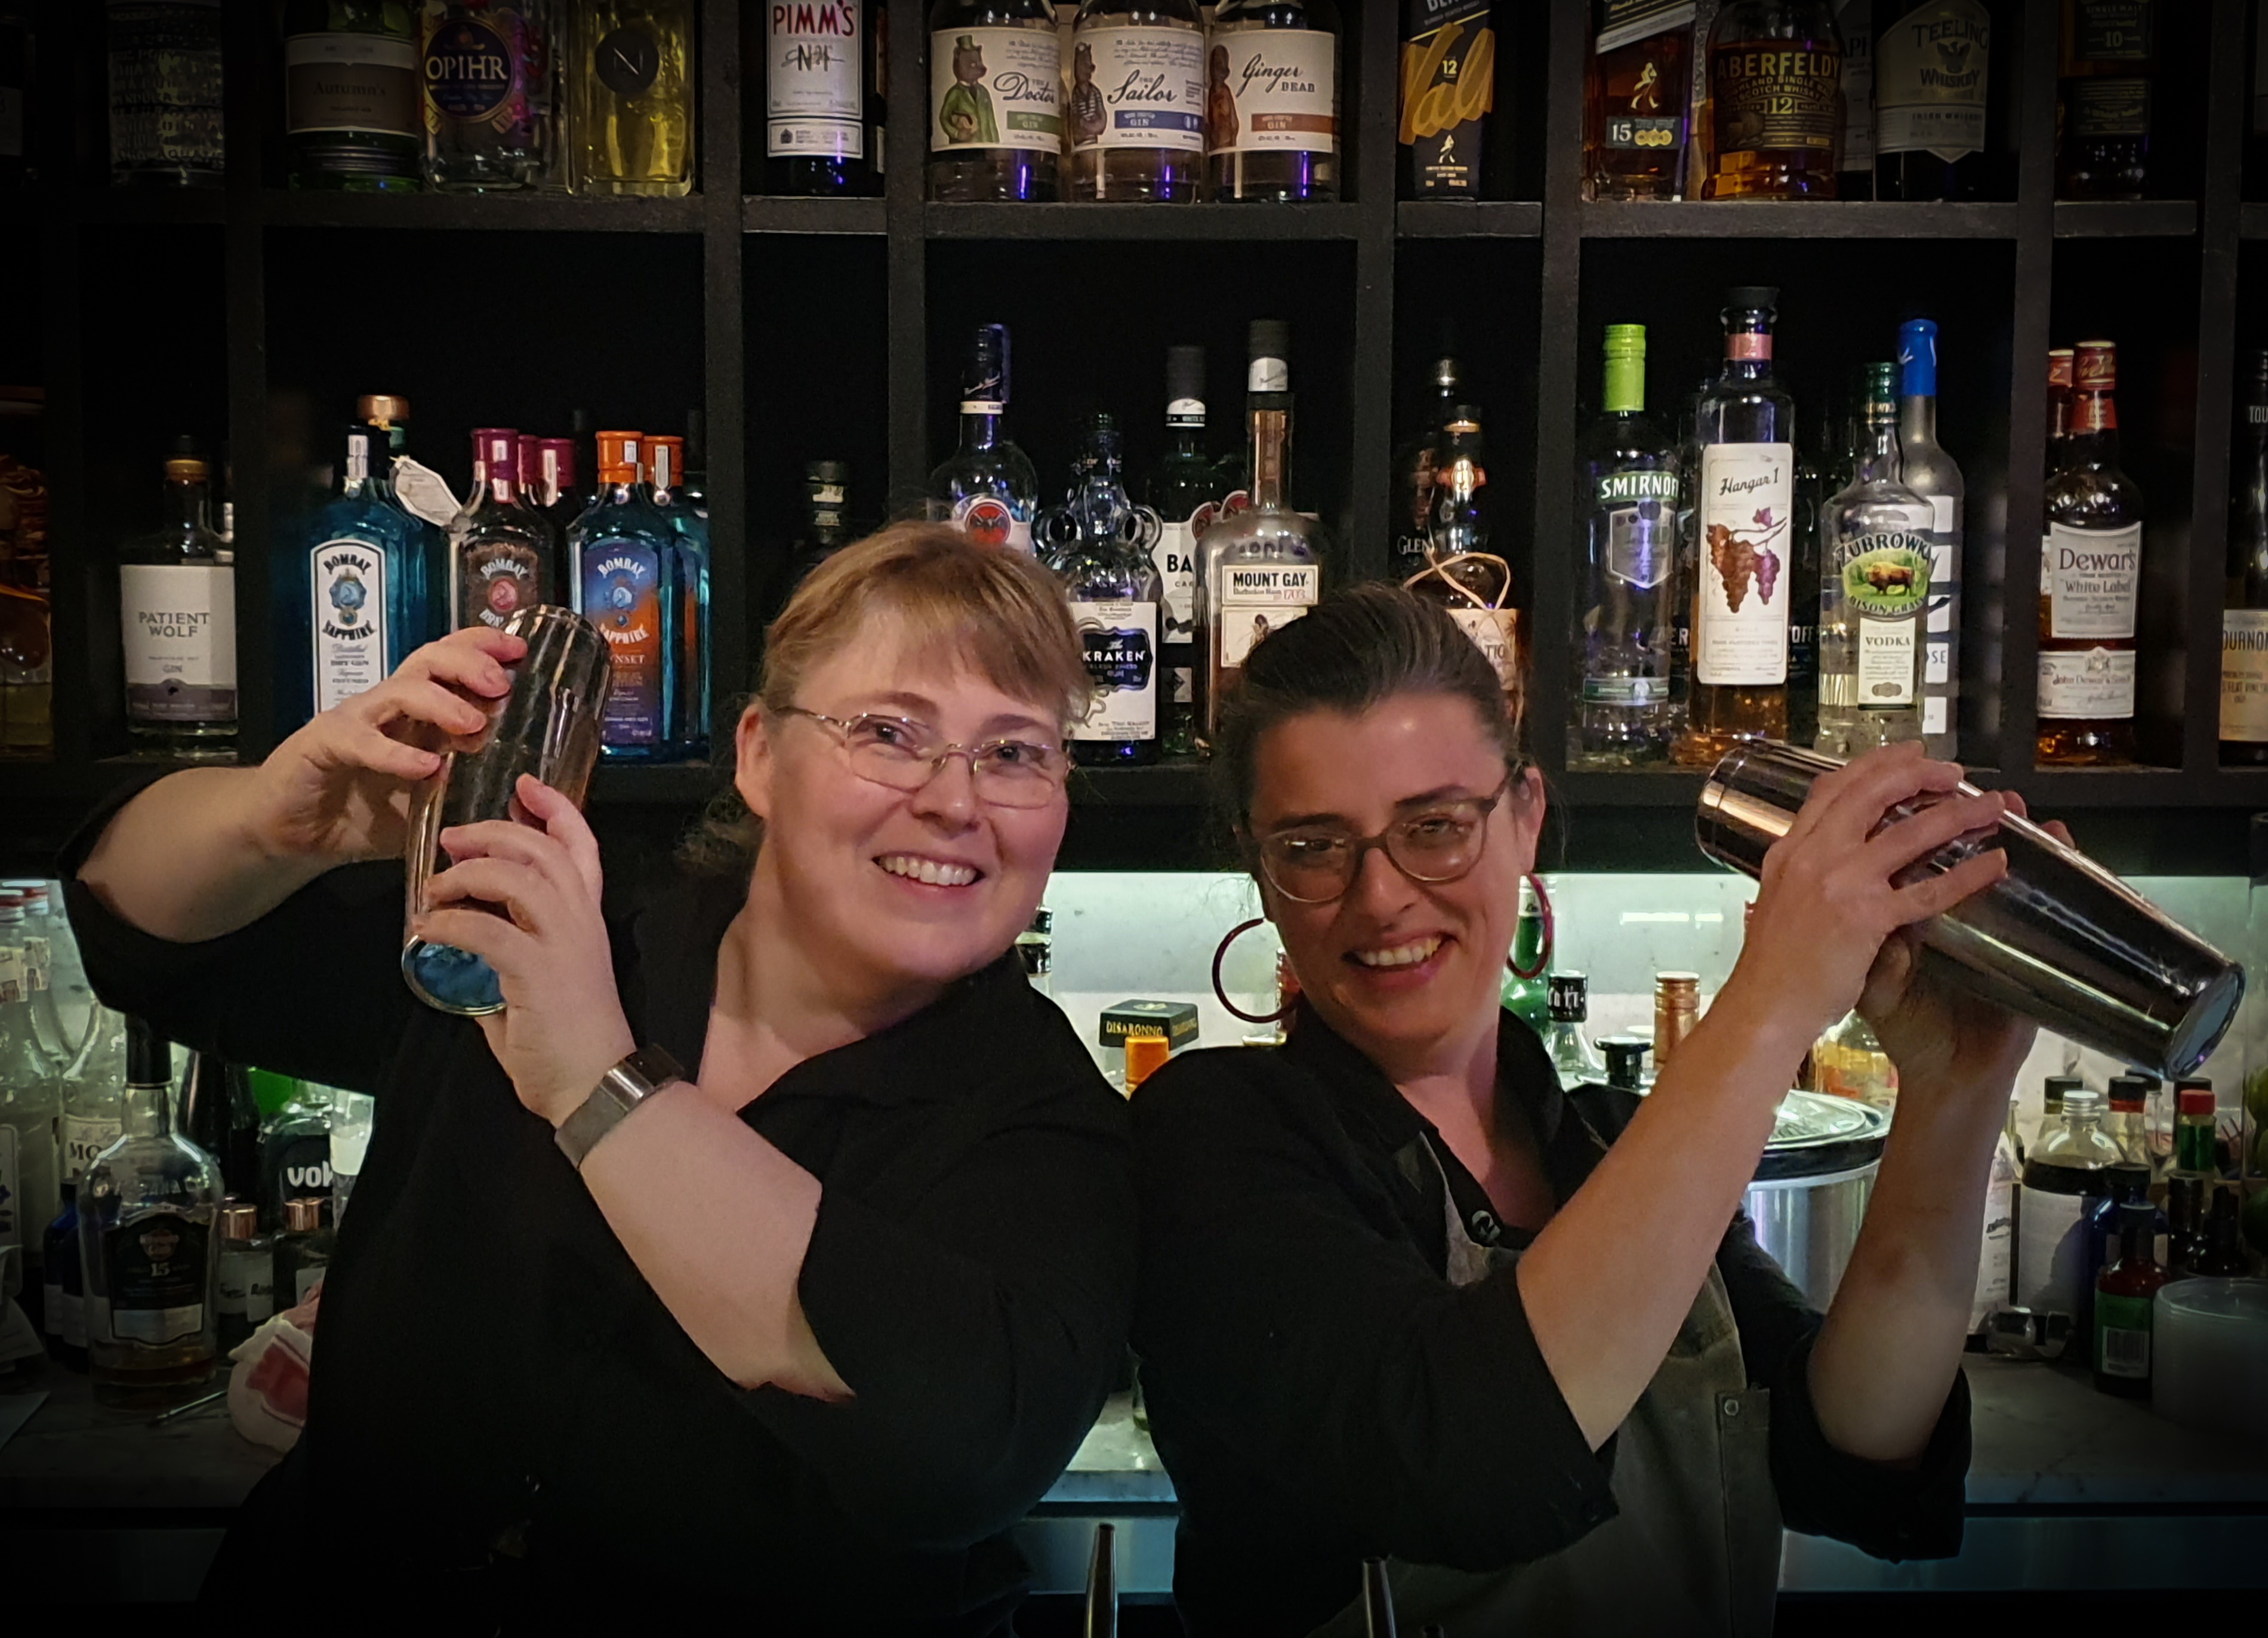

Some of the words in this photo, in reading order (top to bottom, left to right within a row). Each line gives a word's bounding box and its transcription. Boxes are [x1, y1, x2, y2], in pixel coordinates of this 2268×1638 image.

[774, 0, 855, 36] PIMM'S
[1912, 19, 1988, 50] TEELING
[2106, 30, 2123, 47] 10
[426, 54, 508, 81] OPIHR
[1235, 53, 1303, 98] Ginger
[1443, 60, 1458, 74] 12
[1717, 52, 1840, 81] ABERFELDY
[993, 72, 1055, 103] Doctor
[1107, 69, 1178, 104] Sailor
[1920, 68, 1980, 88] WHISKEY
[313, 81, 386, 96] Autumn's
[1770, 97, 1793, 114] 12
[1130, 118, 1150, 127] GIN
[1613, 123, 1632, 142] 15
[1719, 475, 1770, 496] Hangar
[323, 553, 372, 575] BOMBAY
[480, 558, 529, 580] BOMBAY
[597, 557, 646, 579] BOMBAY
[2059, 548, 2136, 571] Dewar's
[1233, 572, 1279, 587] MOUNT
[1283, 572, 1307, 587] GAY
[138, 611, 209, 624] PATIENT
[149, 626, 198, 638] WOLF
[322, 620, 376, 641] SAPPHIRE
[1865, 636, 1910, 646] VODKA
[1082, 650, 1145, 662] KRAKEN
[1106, 1020, 1163, 1037] DISARONNO
